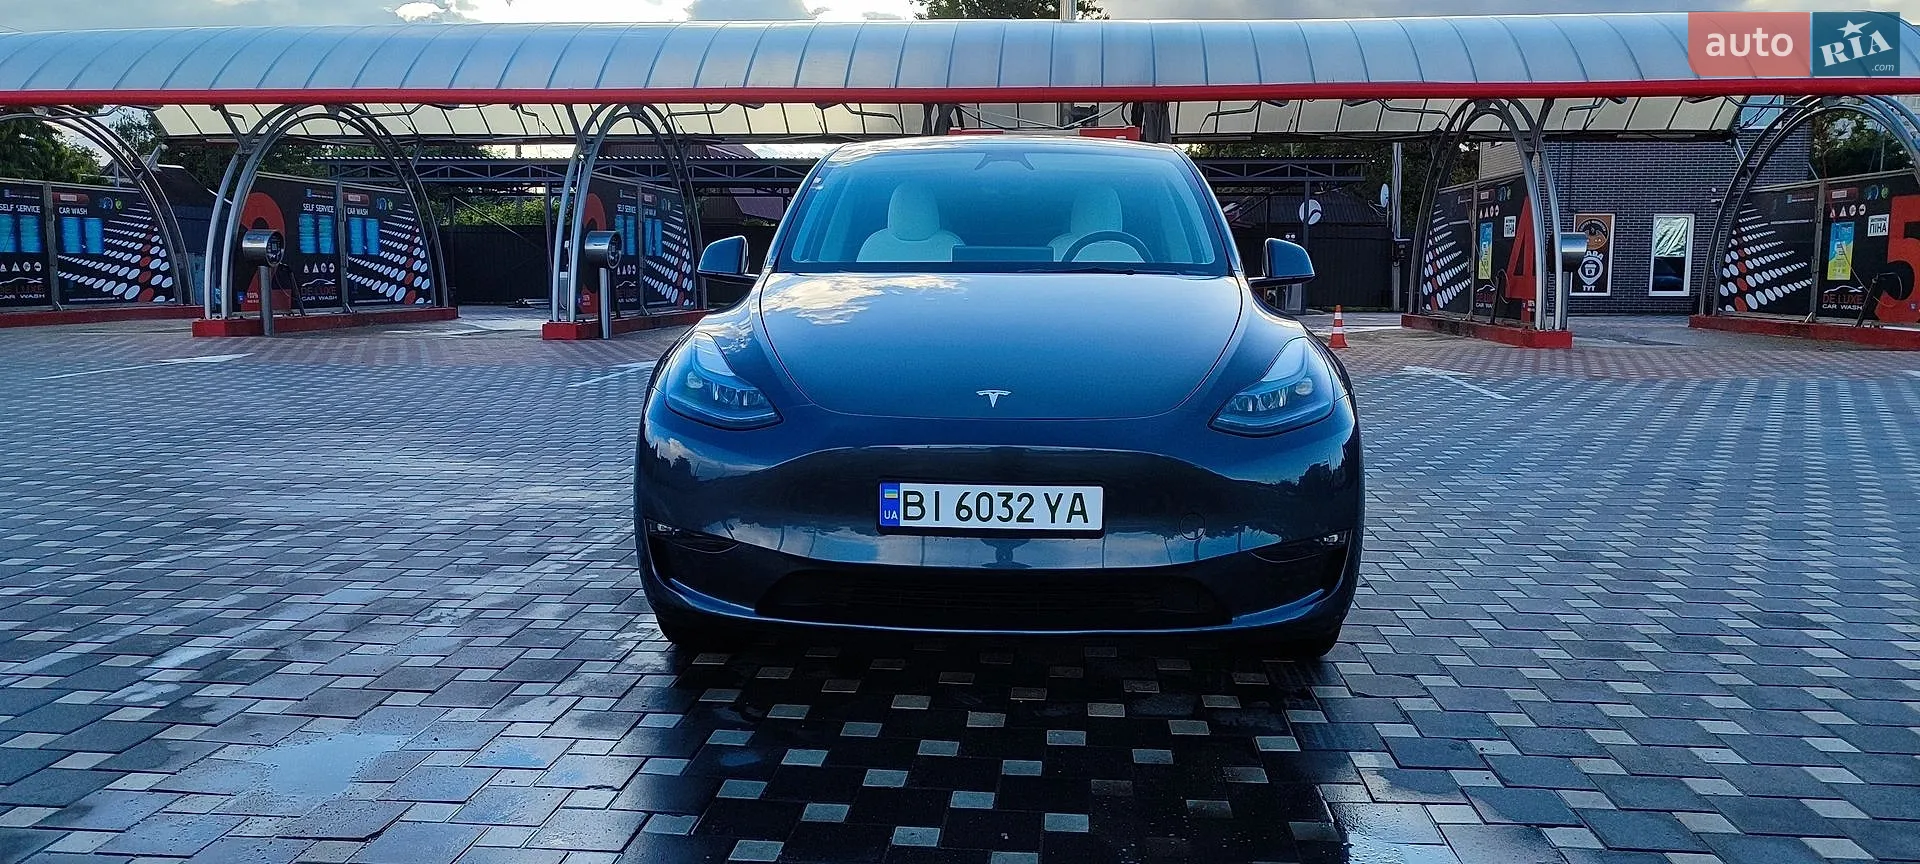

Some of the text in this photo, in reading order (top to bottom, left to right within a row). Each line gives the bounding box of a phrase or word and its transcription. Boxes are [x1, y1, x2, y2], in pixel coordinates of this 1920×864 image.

[0, 203, 41, 213] SELF SERVICE
[58, 206, 88, 215] CAR WASH
[302, 203, 335, 214] SELF SERVICE
[1869, 222, 1887, 234] ПІНА
[1873, 195, 1920, 323] 5
[1822, 293, 1864, 305] DE LUXE
[902, 490, 1090, 524] BI 6032 YA
[883, 510, 899, 520] UA
